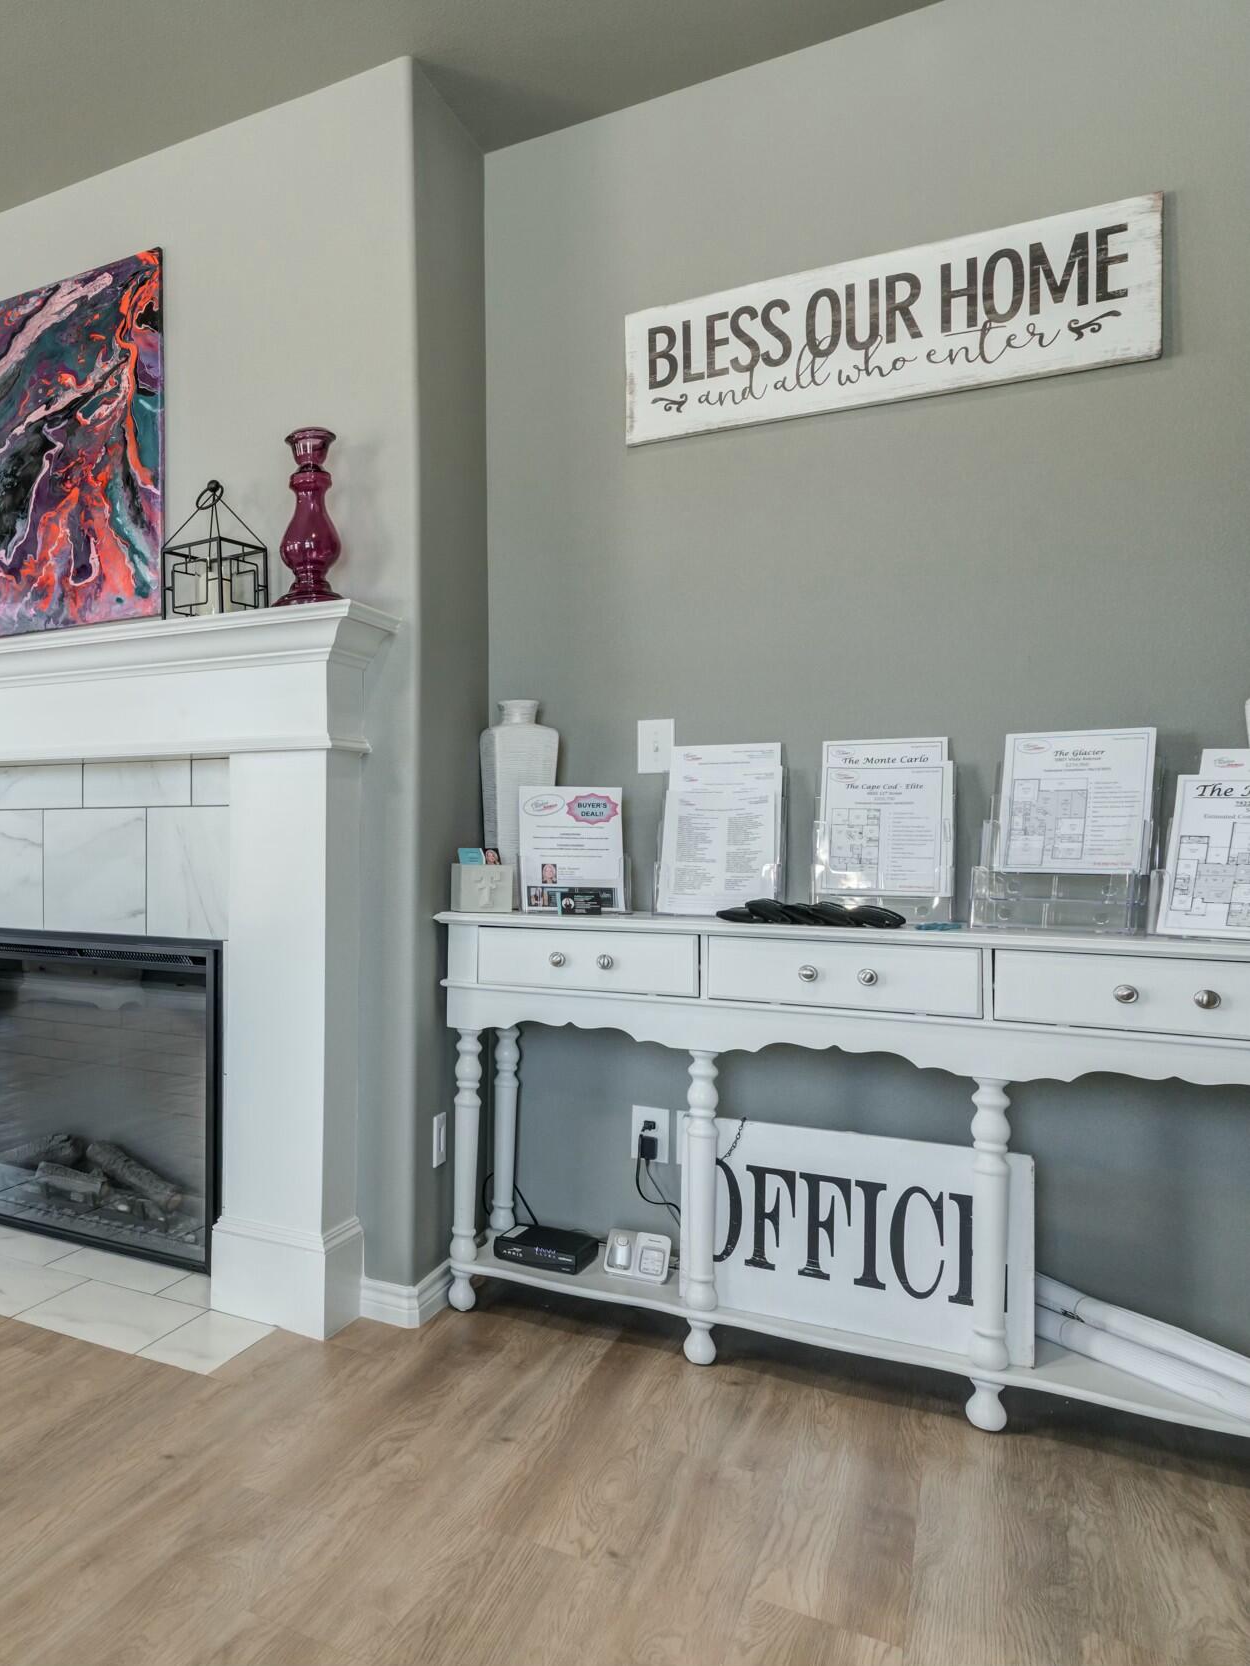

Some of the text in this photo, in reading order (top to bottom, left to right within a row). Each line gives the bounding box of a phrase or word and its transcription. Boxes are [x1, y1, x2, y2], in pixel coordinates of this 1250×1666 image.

[648, 222, 1129, 390] BLESS OUR HOME
[697, 319, 1061, 406] and all who enter
[842, 754, 929, 765] The Monte Carlo
[1195, 782, 1234, 797] The
